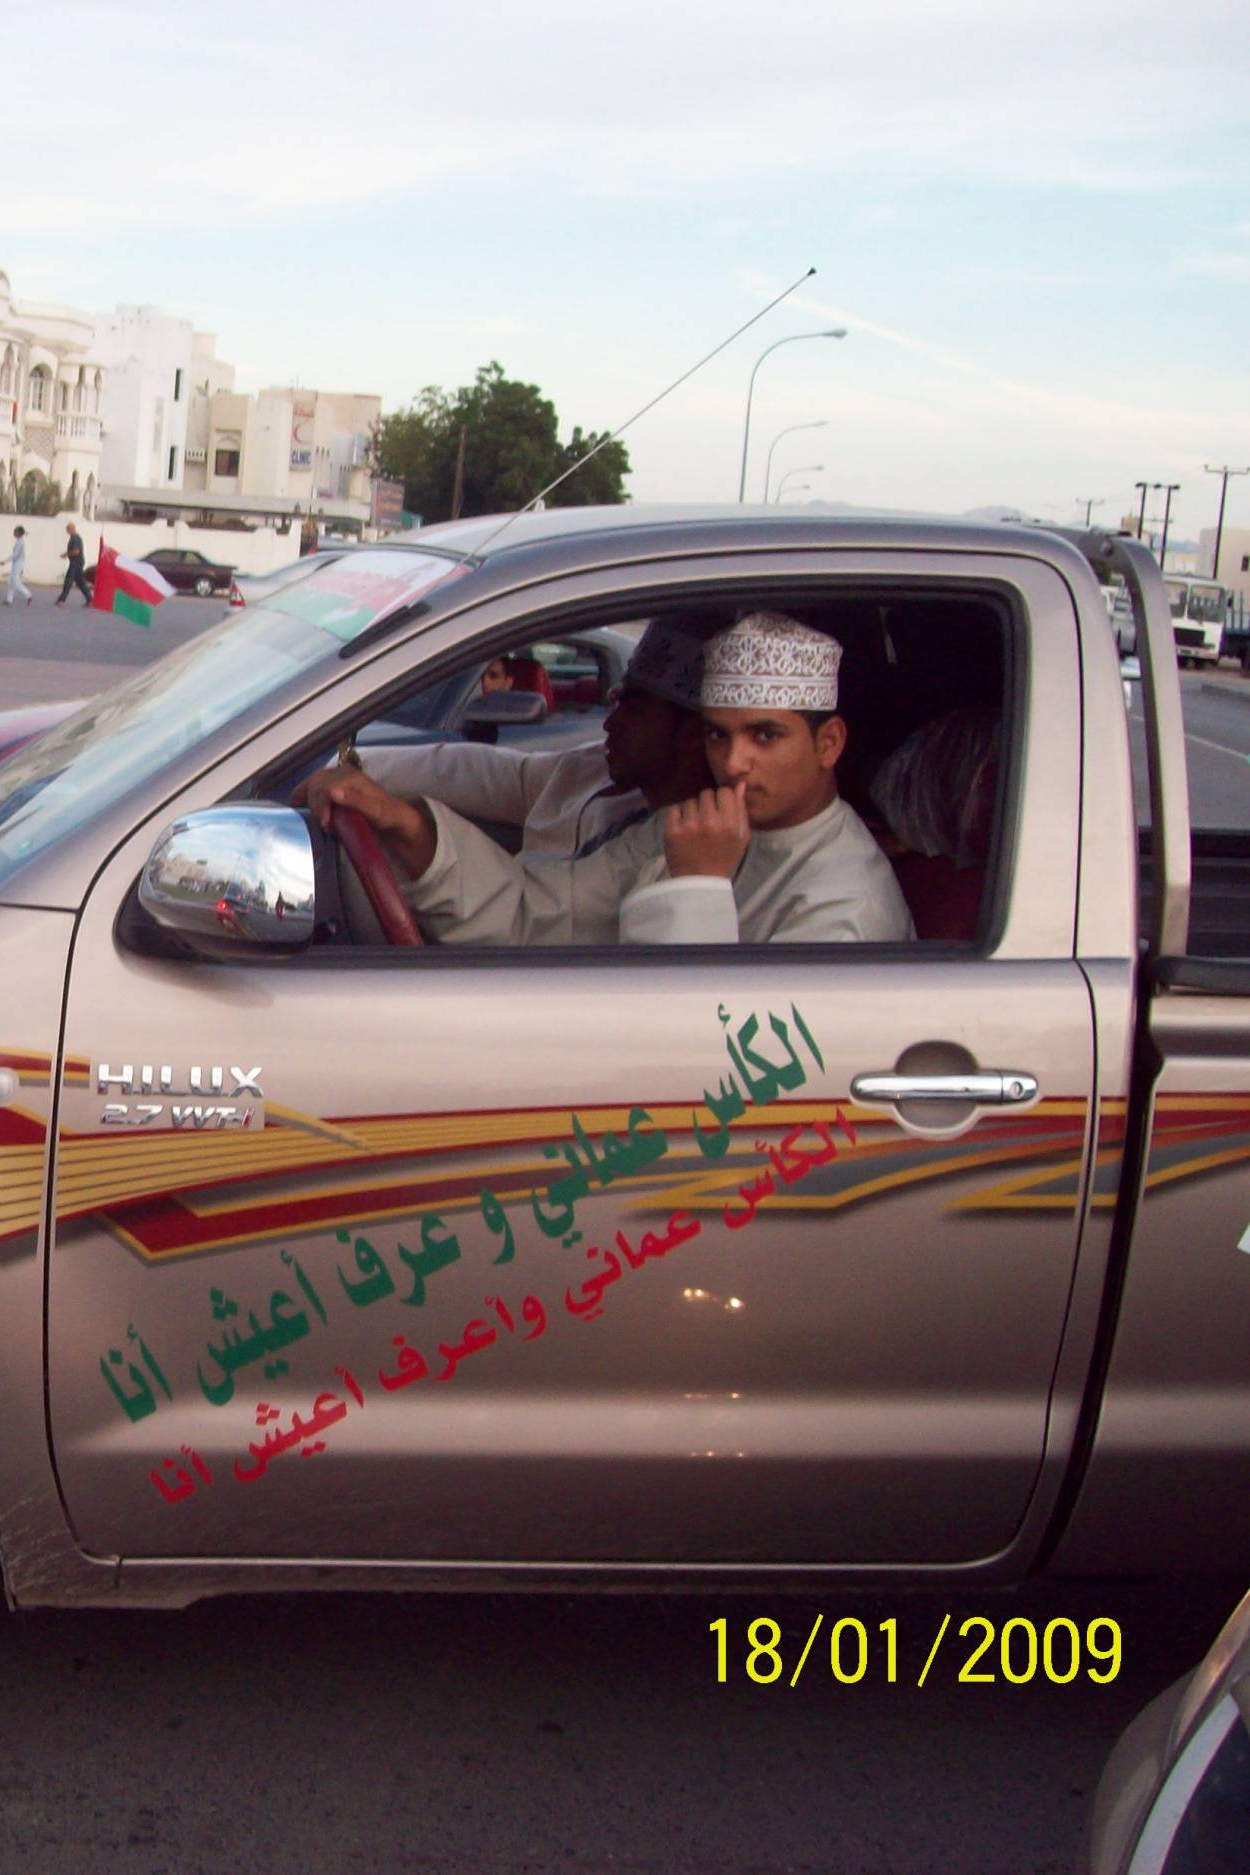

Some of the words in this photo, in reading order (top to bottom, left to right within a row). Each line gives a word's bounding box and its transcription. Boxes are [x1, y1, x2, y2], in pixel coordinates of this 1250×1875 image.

[97, 1064, 264, 1098] HILUX
[101, 1103, 163, 1125] 2.7
[693, 1001, 826, 1159] الكأس
[480, 1187, 516, 1265] و
[532, 1105, 669, 1249] عماني
[335, 1213, 461, 1307] عرف
[564, 1209, 702, 1322] عماني
[99, 1322, 174, 1424] أنا
[197, 1248, 328, 1406] أعيش
